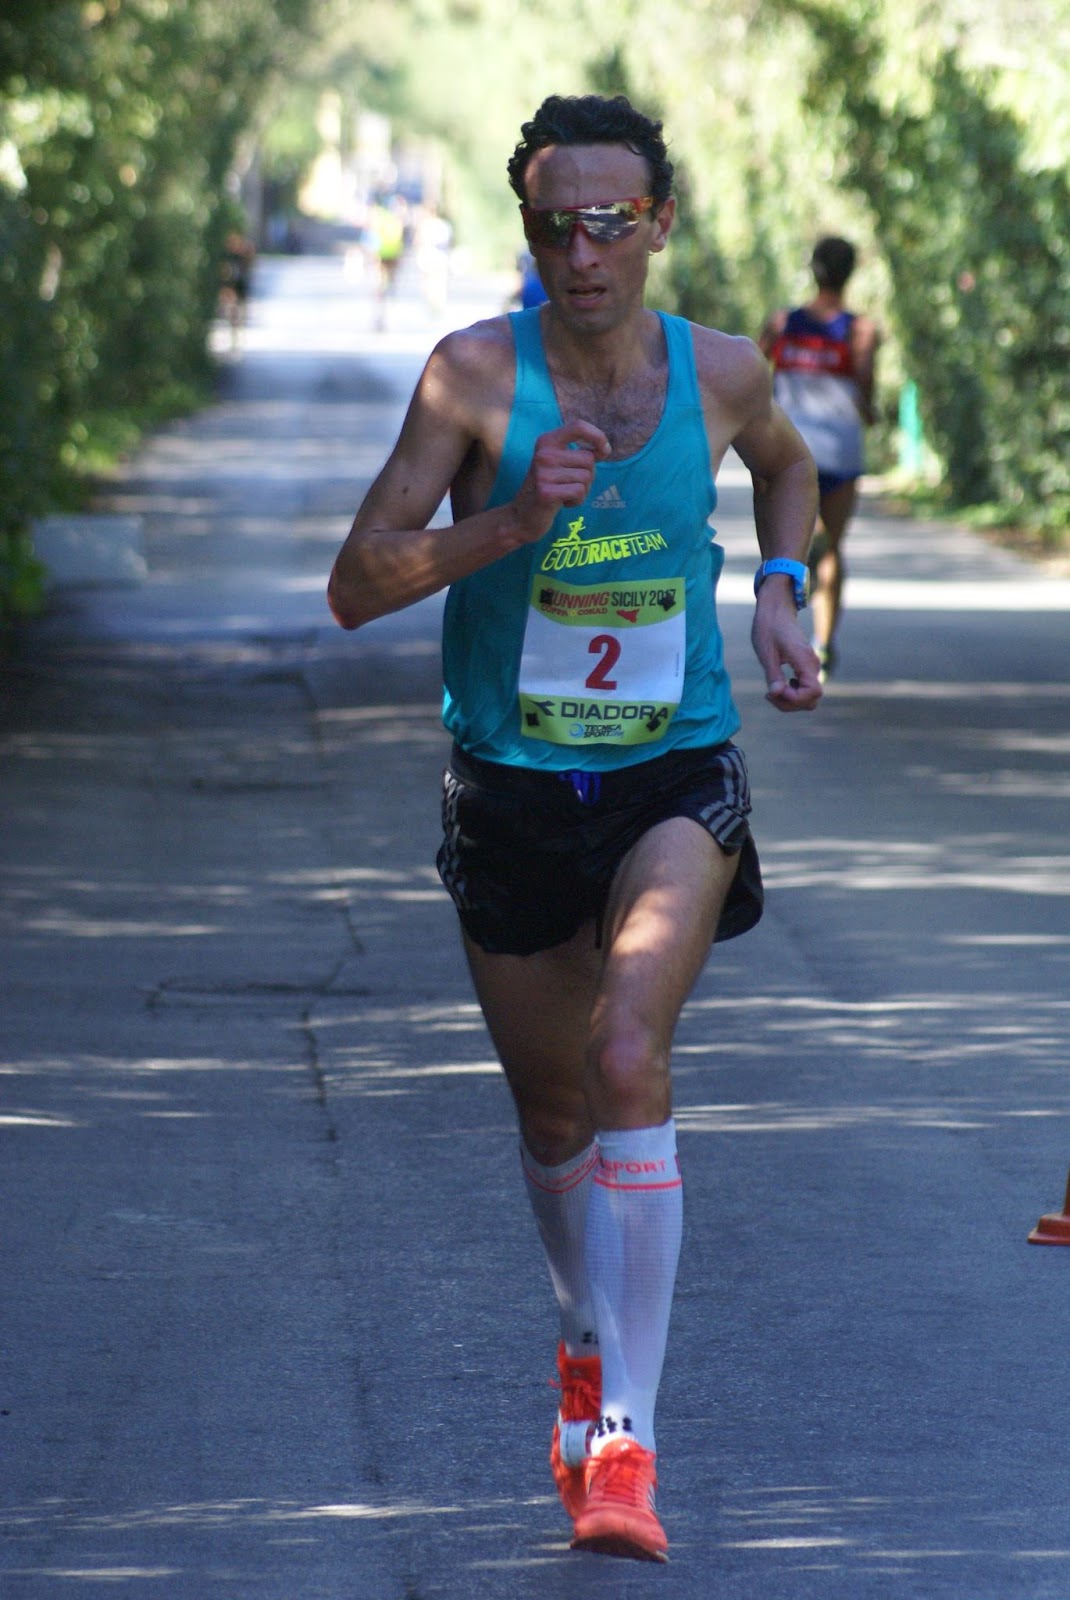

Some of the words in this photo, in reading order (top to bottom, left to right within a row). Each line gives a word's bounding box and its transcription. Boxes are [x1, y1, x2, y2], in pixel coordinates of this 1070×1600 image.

[591, 500, 627, 509] adidas
[546, 588, 610, 608] UNNING
[611, 590, 647, 607] SICILY
[585, 634, 621, 690] 2
[561, 701, 669, 720] DIADORA
